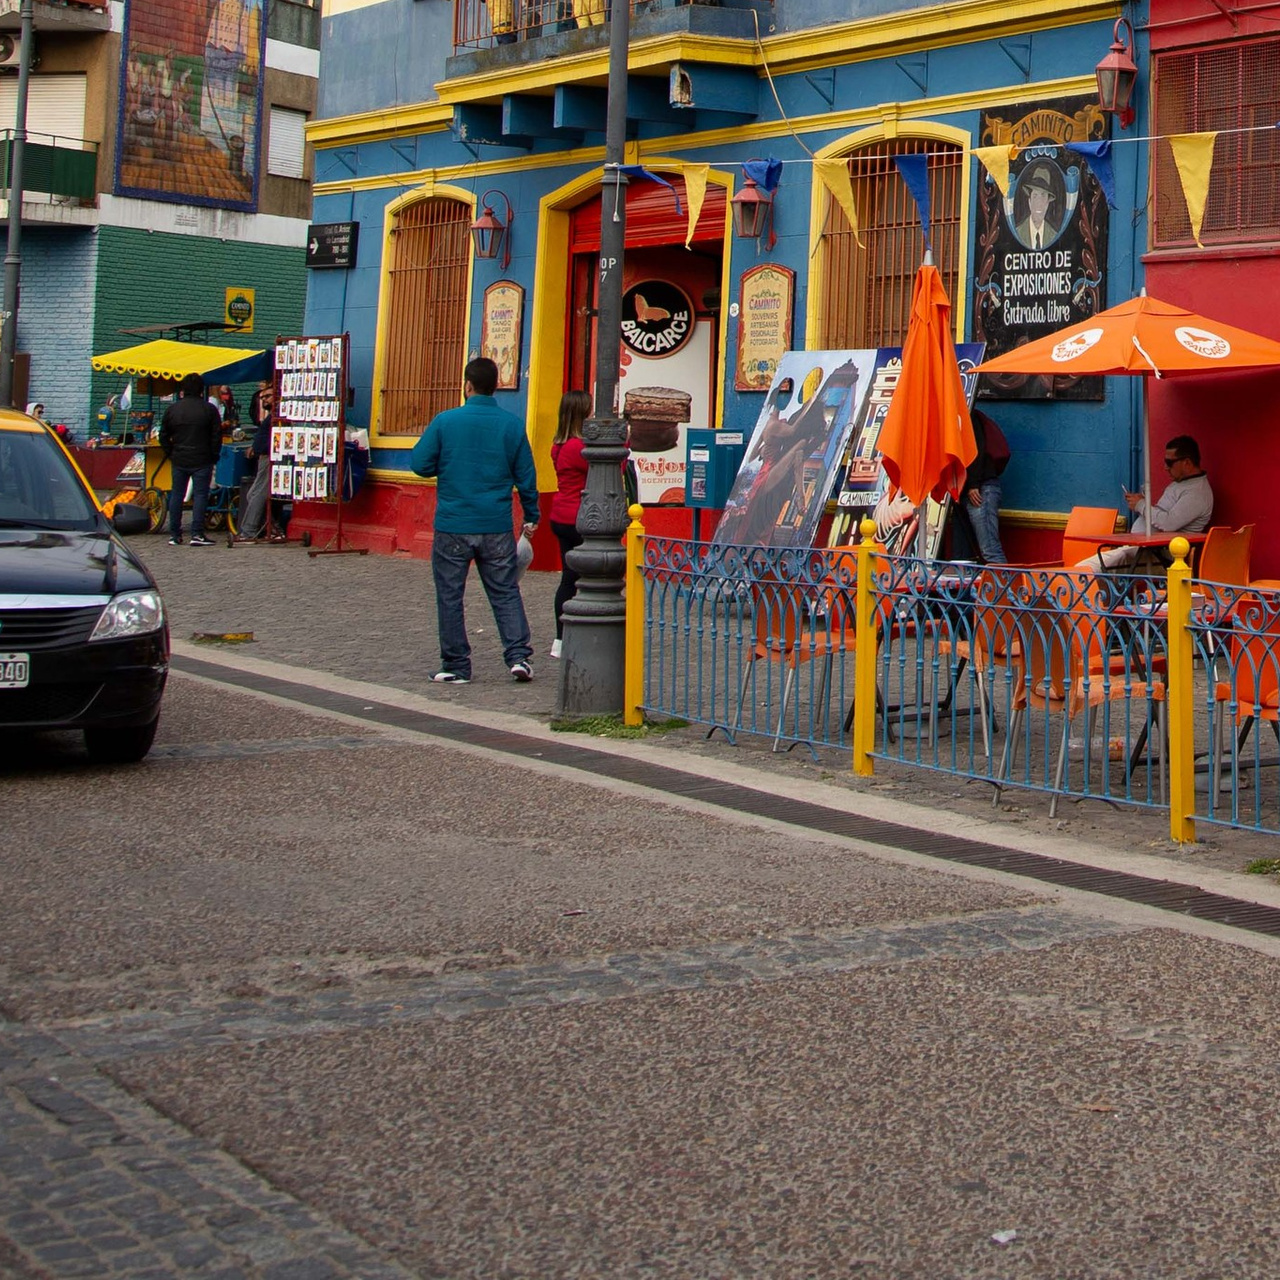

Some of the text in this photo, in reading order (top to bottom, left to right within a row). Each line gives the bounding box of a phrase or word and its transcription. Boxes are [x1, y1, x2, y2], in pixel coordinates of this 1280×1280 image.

[1012, 114, 1074, 146] CAMINITO
[1004, 250, 1072, 271] CENTRO DE
[1004, 272, 1072, 297] EXPOSICIONES
[748, 298, 781, 310] CAMINITO
[1003, 299, 1070, 326] Entrada libre
[621, 310, 689, 352] BALCARCE
[840, 492, 874, 506] CAMINITO
